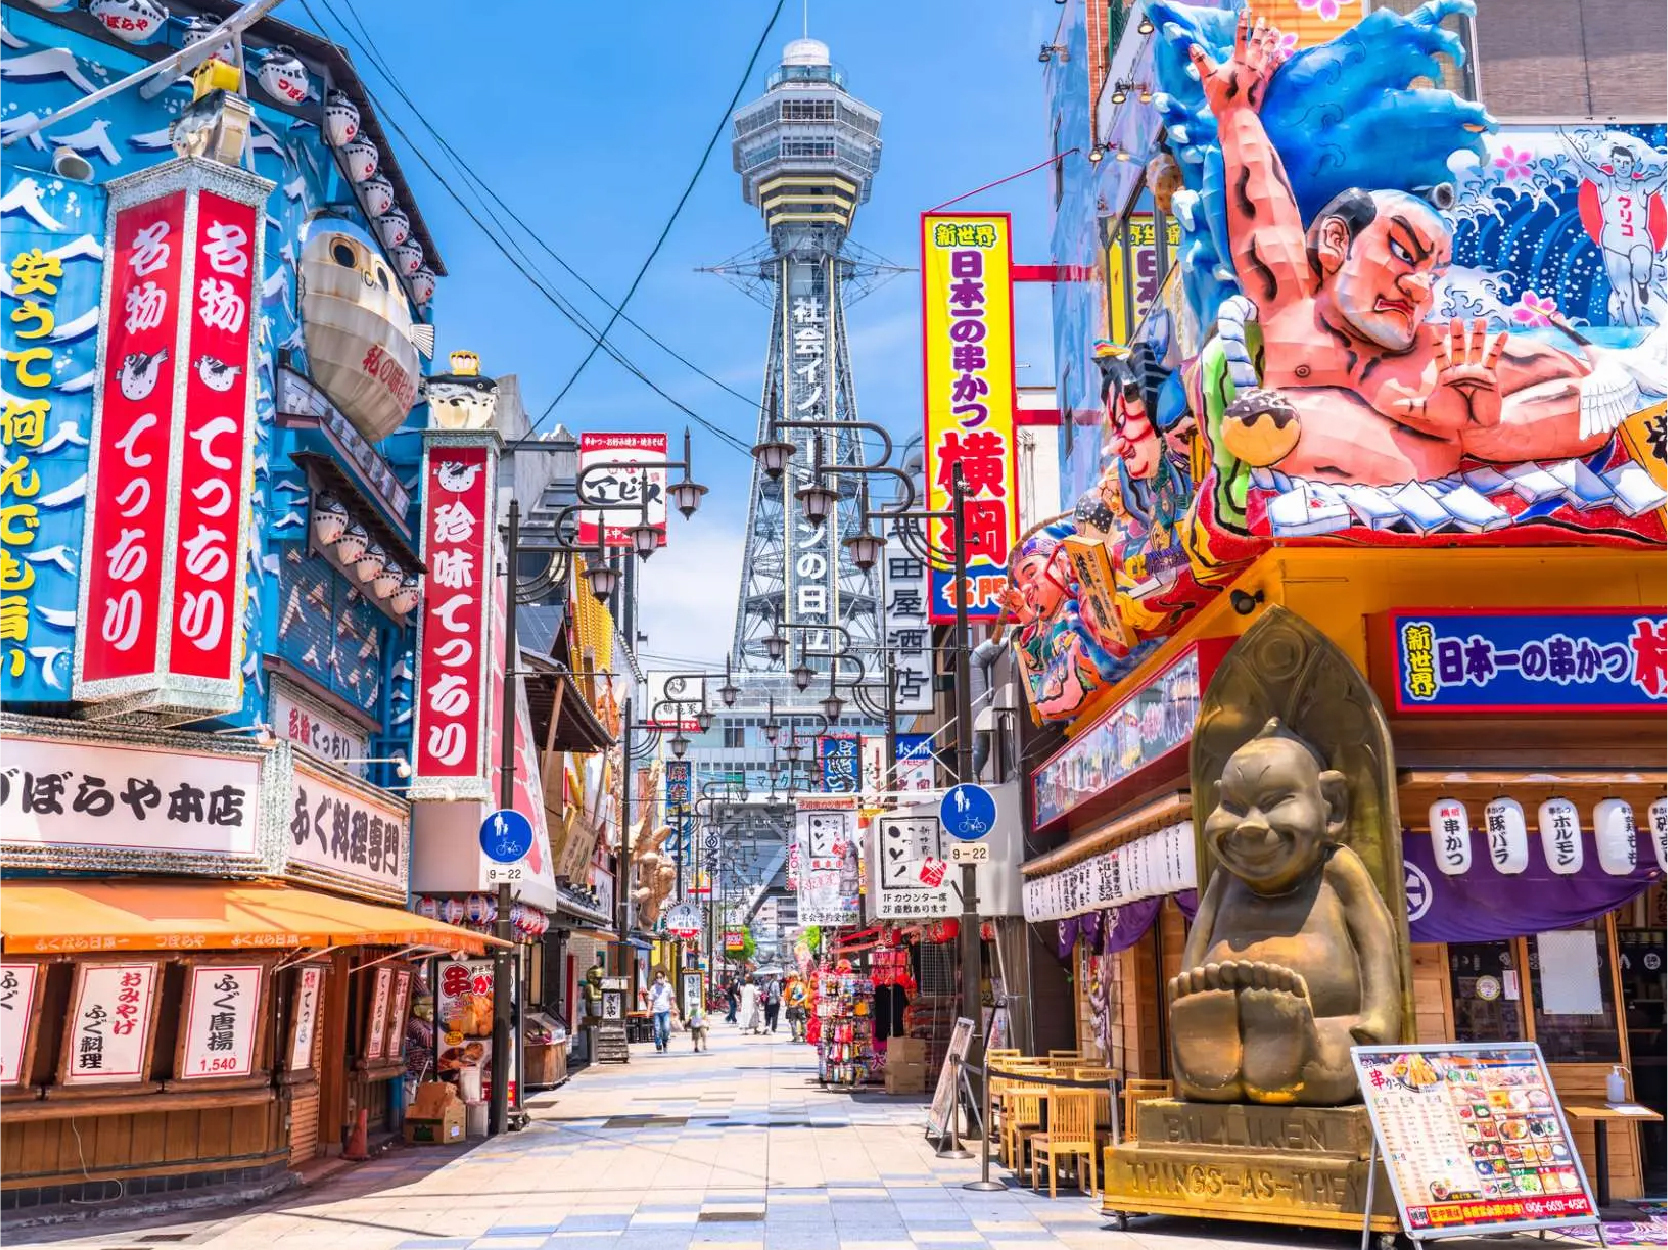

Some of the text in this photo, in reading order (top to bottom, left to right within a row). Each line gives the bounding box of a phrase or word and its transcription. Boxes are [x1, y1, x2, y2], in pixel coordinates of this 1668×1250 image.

[936, 223, 998, 248] 新世界
[125, 221, 171, 334] 名物
[199, 220, 249, 335] 名物
[949, 250, 989, 429] 日本一の串かつ
[937, 431, 1007, 567] 横綱
[102, 413, 158, 652] てっちり
[179, 416, 238, 652] てっちり
[426, 502, 476, 767] 珍味てっちり
[1404, 625, 1436, 697] 新世界
[1438, 636, 1630, 684] 日本一の串かつ
[952, 847, 987, 860] 9-22
[1443, 818, 1464, 866] 串かつ
[1489, 815, 1510, 865] 豚バラ
[1552, 815, 1576, 867] ホルモン
[489, 868, 521, 880] 9-22
[113, 972, 142, 1036] おみやげ
[207, 973, 240, 1052] ふぐ唐揚
[443, 963, 495, 999] 串か
[79, 1004, 108, 1070] ふぐ料理
[200, 1057, 237, 1072] 1,540
[1163, 1112, 1327, 1152] BILLIKEN
